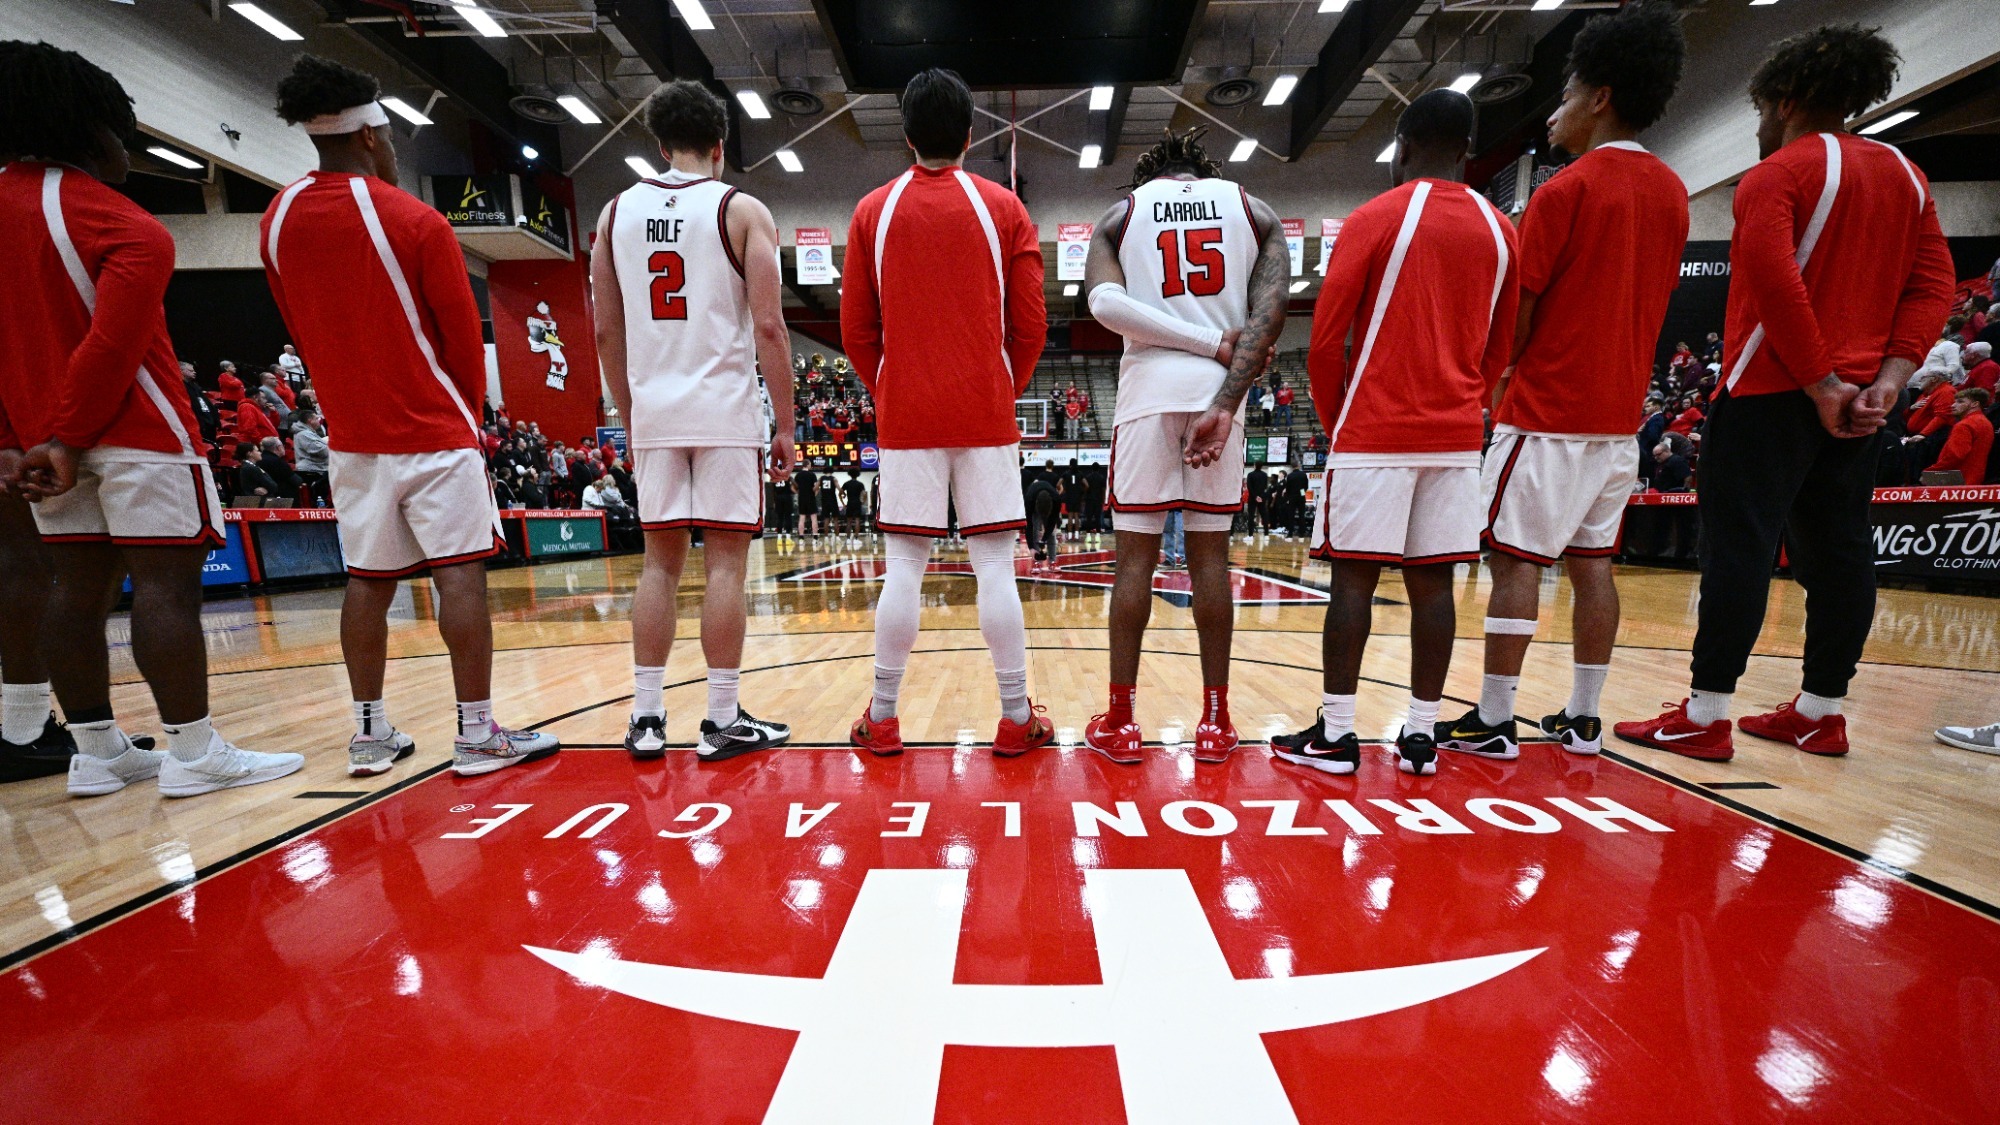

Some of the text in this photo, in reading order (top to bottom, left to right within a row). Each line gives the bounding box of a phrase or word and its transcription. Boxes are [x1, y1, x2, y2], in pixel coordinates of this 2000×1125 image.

[446, 210, 506, 221] AxioFitness
[1153, 200, 1222, 222] CARROLL
[646, 218, 684, 243] ROLF
[1156, 227, 1226, 299] 15
[647, 250, 688, 321] 2
[806, 444, 838, 456] 20:00
[1660, 495, 1697, 504] STRETCH
[1071, 796, 1674, 838] HORIZON
